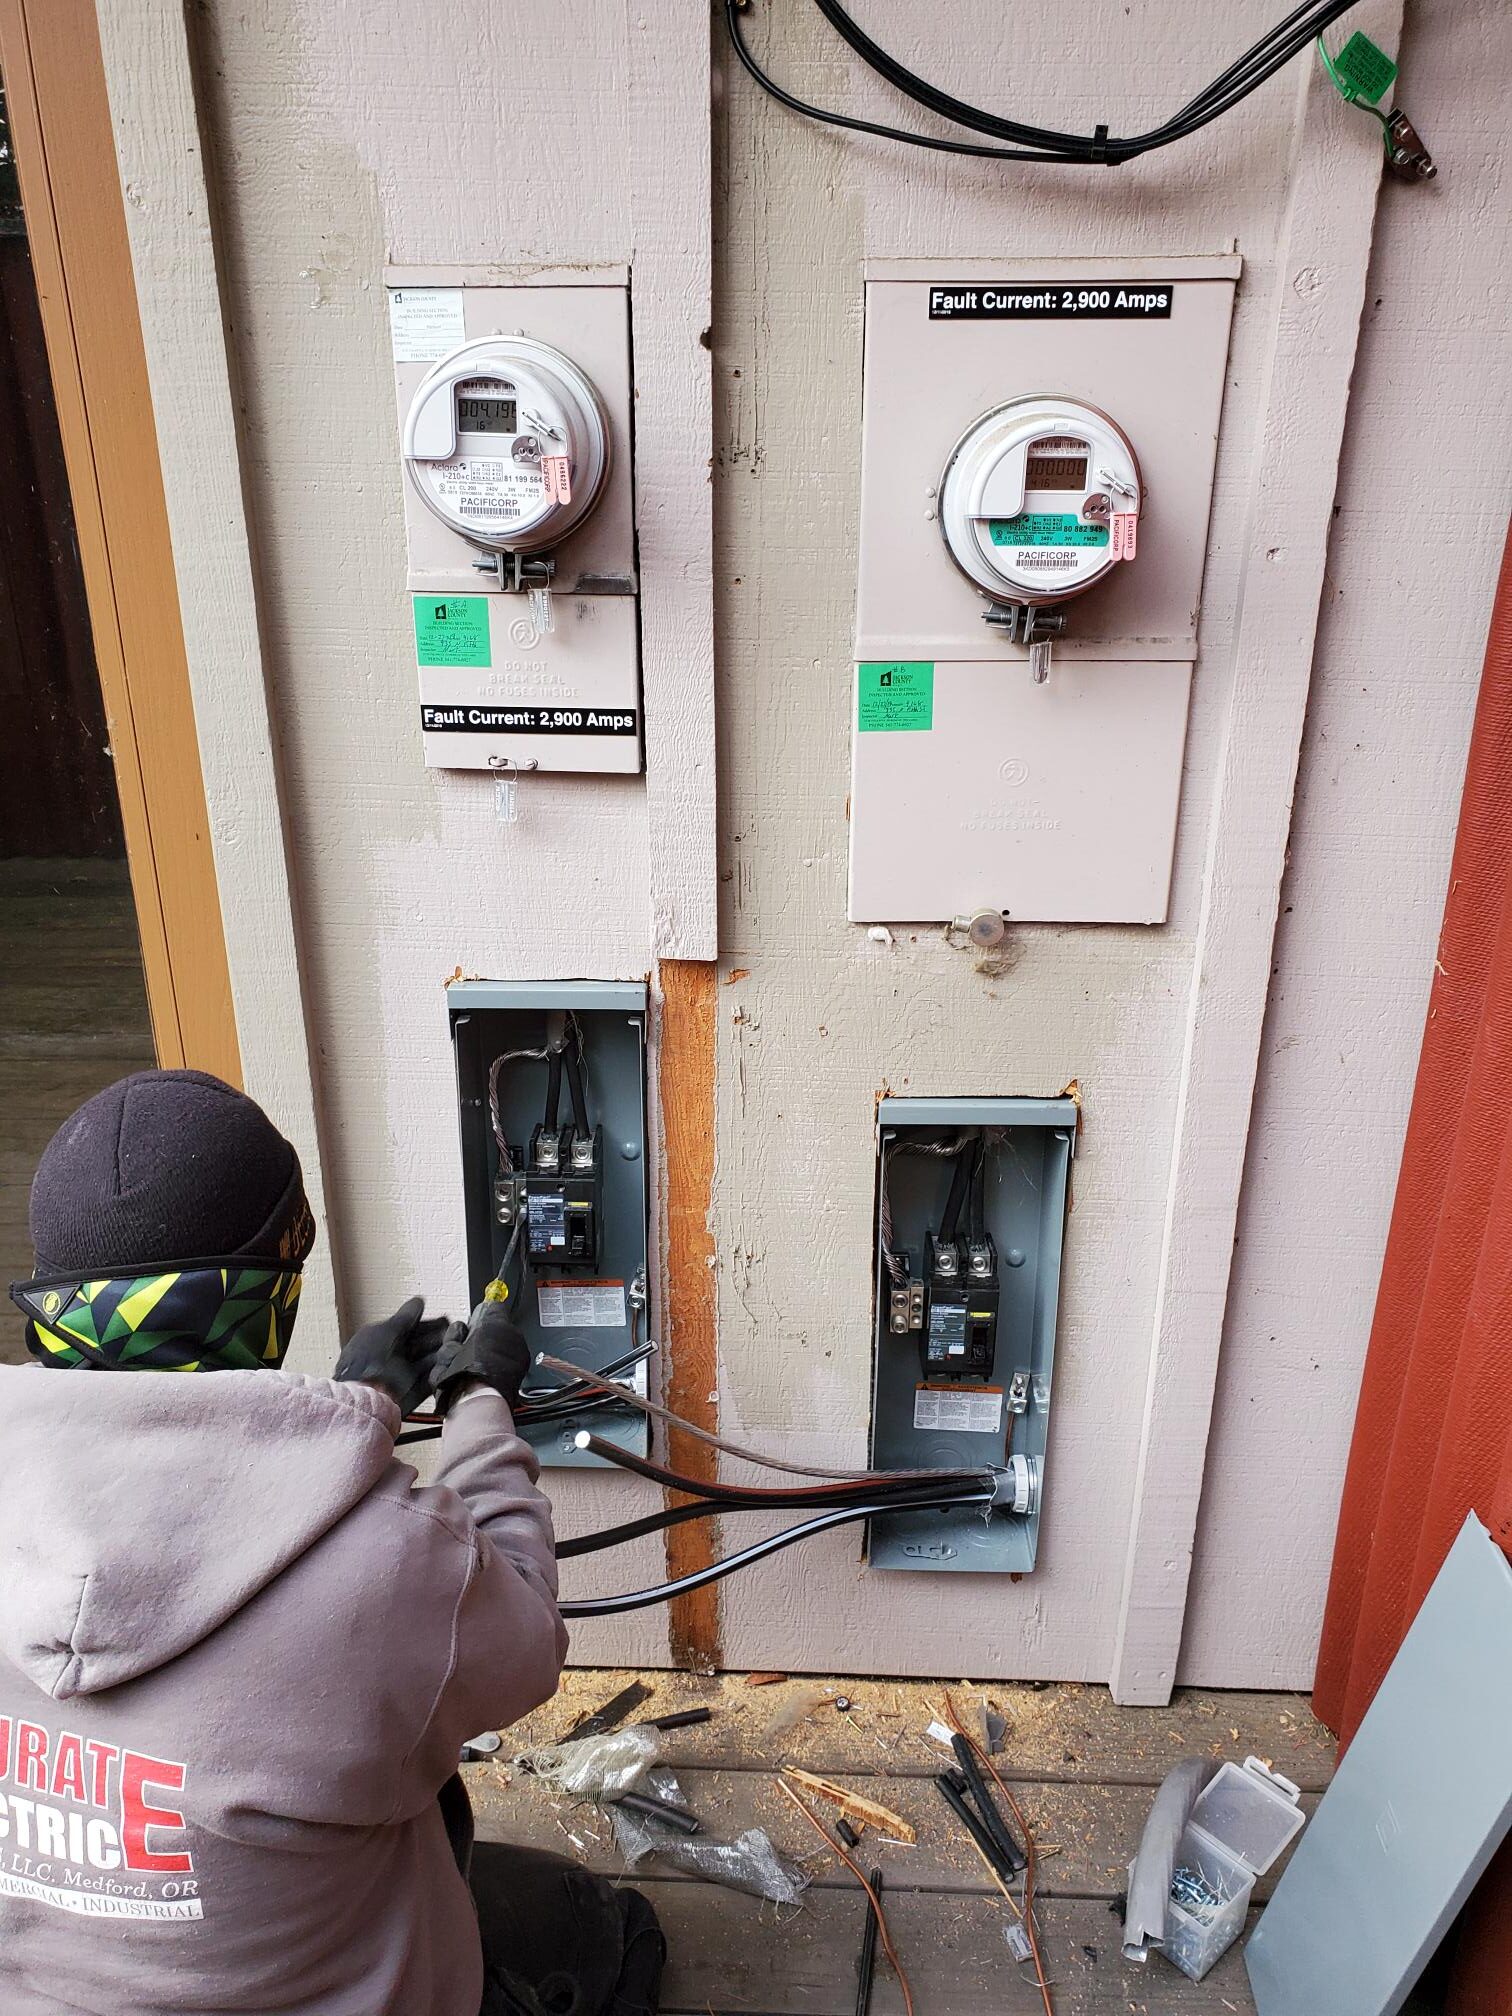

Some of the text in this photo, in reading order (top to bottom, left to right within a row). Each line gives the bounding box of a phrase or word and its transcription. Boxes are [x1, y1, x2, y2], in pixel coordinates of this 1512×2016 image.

[931, 291, 1168, 312] Fault Current: 2,900 Amps
[514, 475, 528, 483] 199
[543, 460, 551, 492] PACIFICORP
[460, 497, 519, 507] PACIFICORP
[1063, 525, 1073, 533] 80
[1074, 525, 1088, 533] 882
[1089, 525, 1103, 533] 949
[1018, 551, 1077, 560] PACIFICORP
[505, 661, 549, 672] DO NOT
[489, 674, 567, 685] BREAK SEAL
[478, 687, 580, 698] NO FUSES INSIDE
[423, 708, 635, 731] Fault Current: 2,900 Amps
[1021, 820, 1062, 831] INSIDE
[11, 1853, 55, 1883] LLC.
[64, 1868, 153, 1899] Medford,
[161, 1880, 199, 1898] OR
[83, 1897, 200, 1918] INDUSTRIAL
